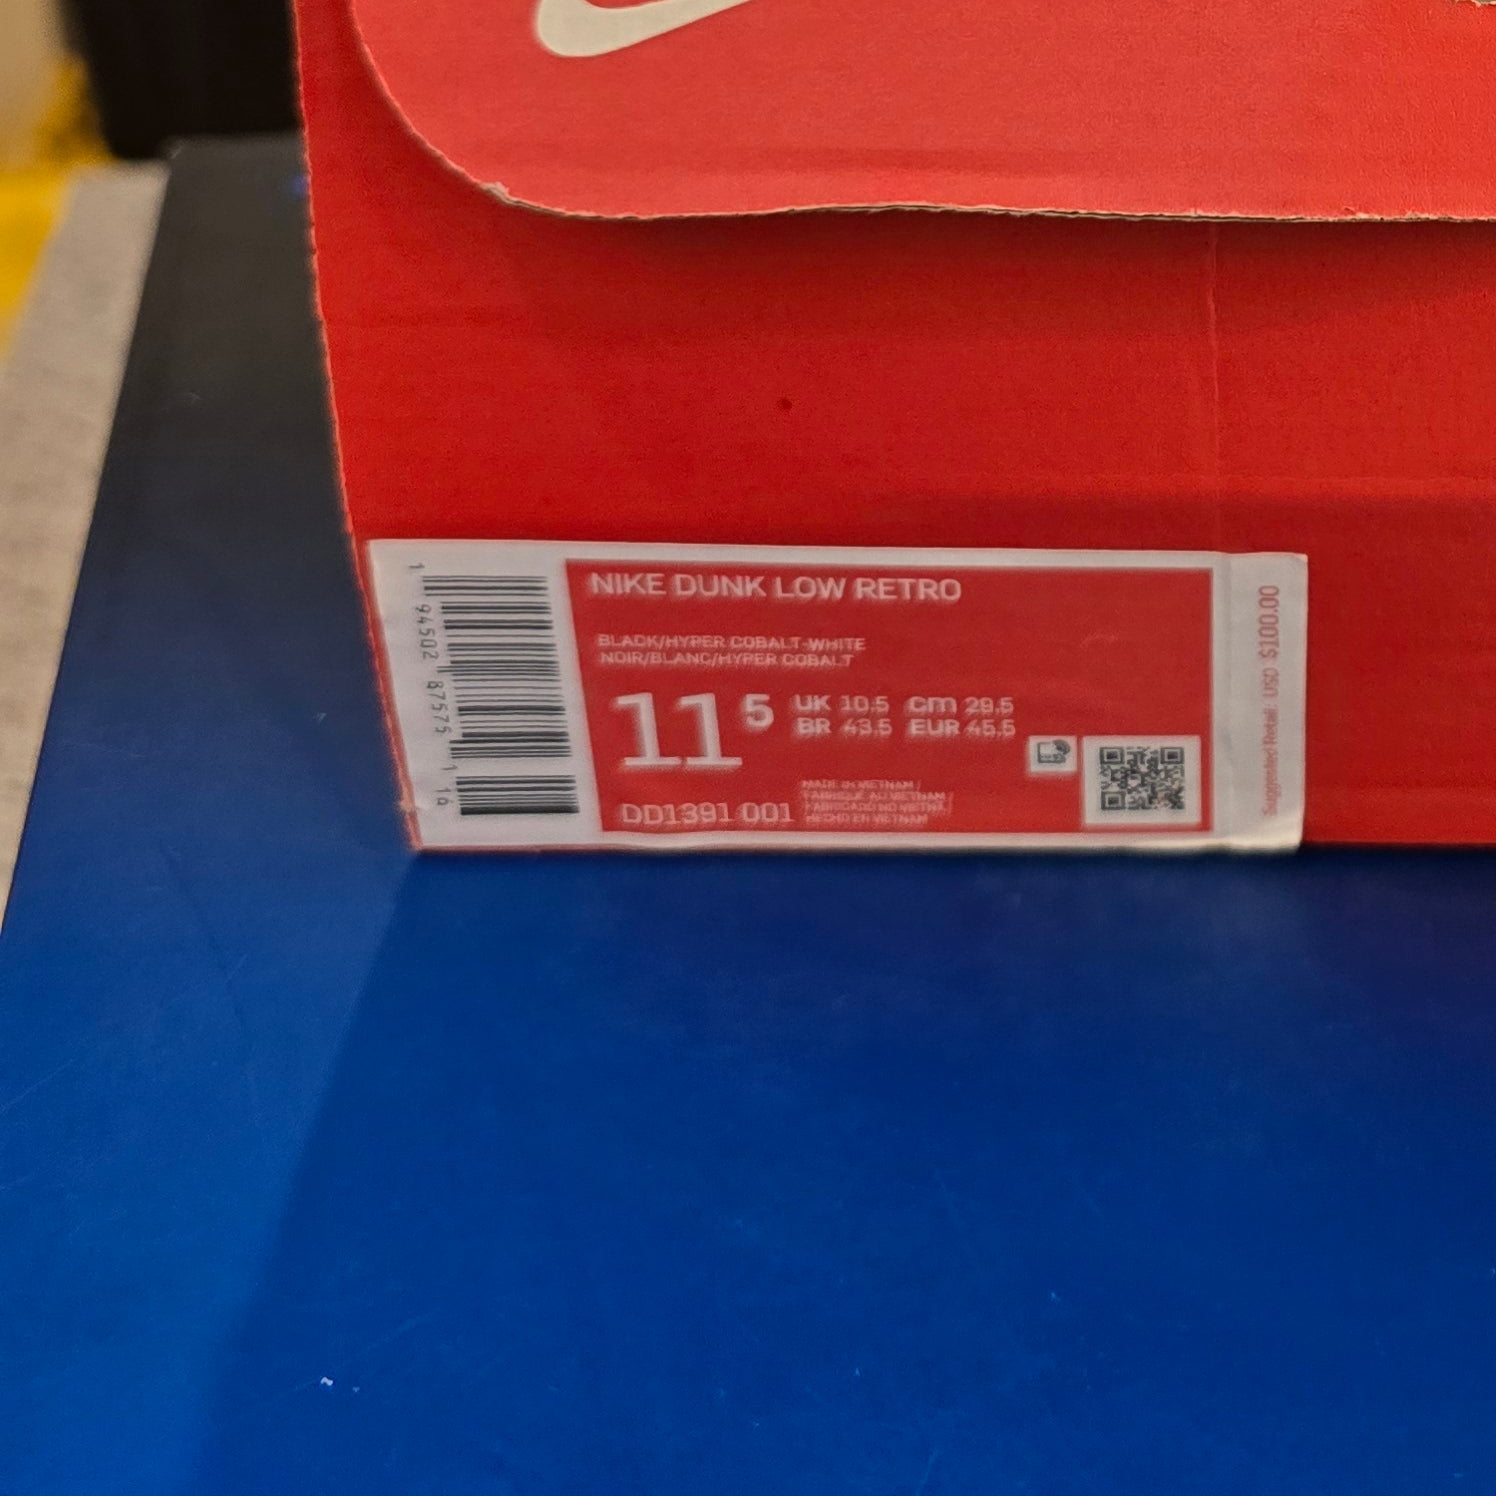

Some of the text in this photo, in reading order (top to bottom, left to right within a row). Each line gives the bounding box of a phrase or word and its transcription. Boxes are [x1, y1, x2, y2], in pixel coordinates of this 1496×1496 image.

[408, 562, 425, 570] 1
[591, 572, 962, 602] NIKE DUNK LOW RETRO
[415, 604, 440, 660] 94502
[1258, 585, 1280, 658] $100.00
[598, 634, 866, 651] BLACK/HYPER COBALT-WHITE
[600, 651, 855, 668] NOIR/BLANC/HYPER COBALT
[1262, 667, 1279, 697] USD
[427, 680, 452, 735] 87575
[794, 694, 831, 712] UK
[839, 695, 890, 713] 10.5
[615, 692, 743, 767] 11
[797, 717, 1016, 736] BR 43.5 EUR 45.5
[621, 802, 795, 824] DD1391 001
